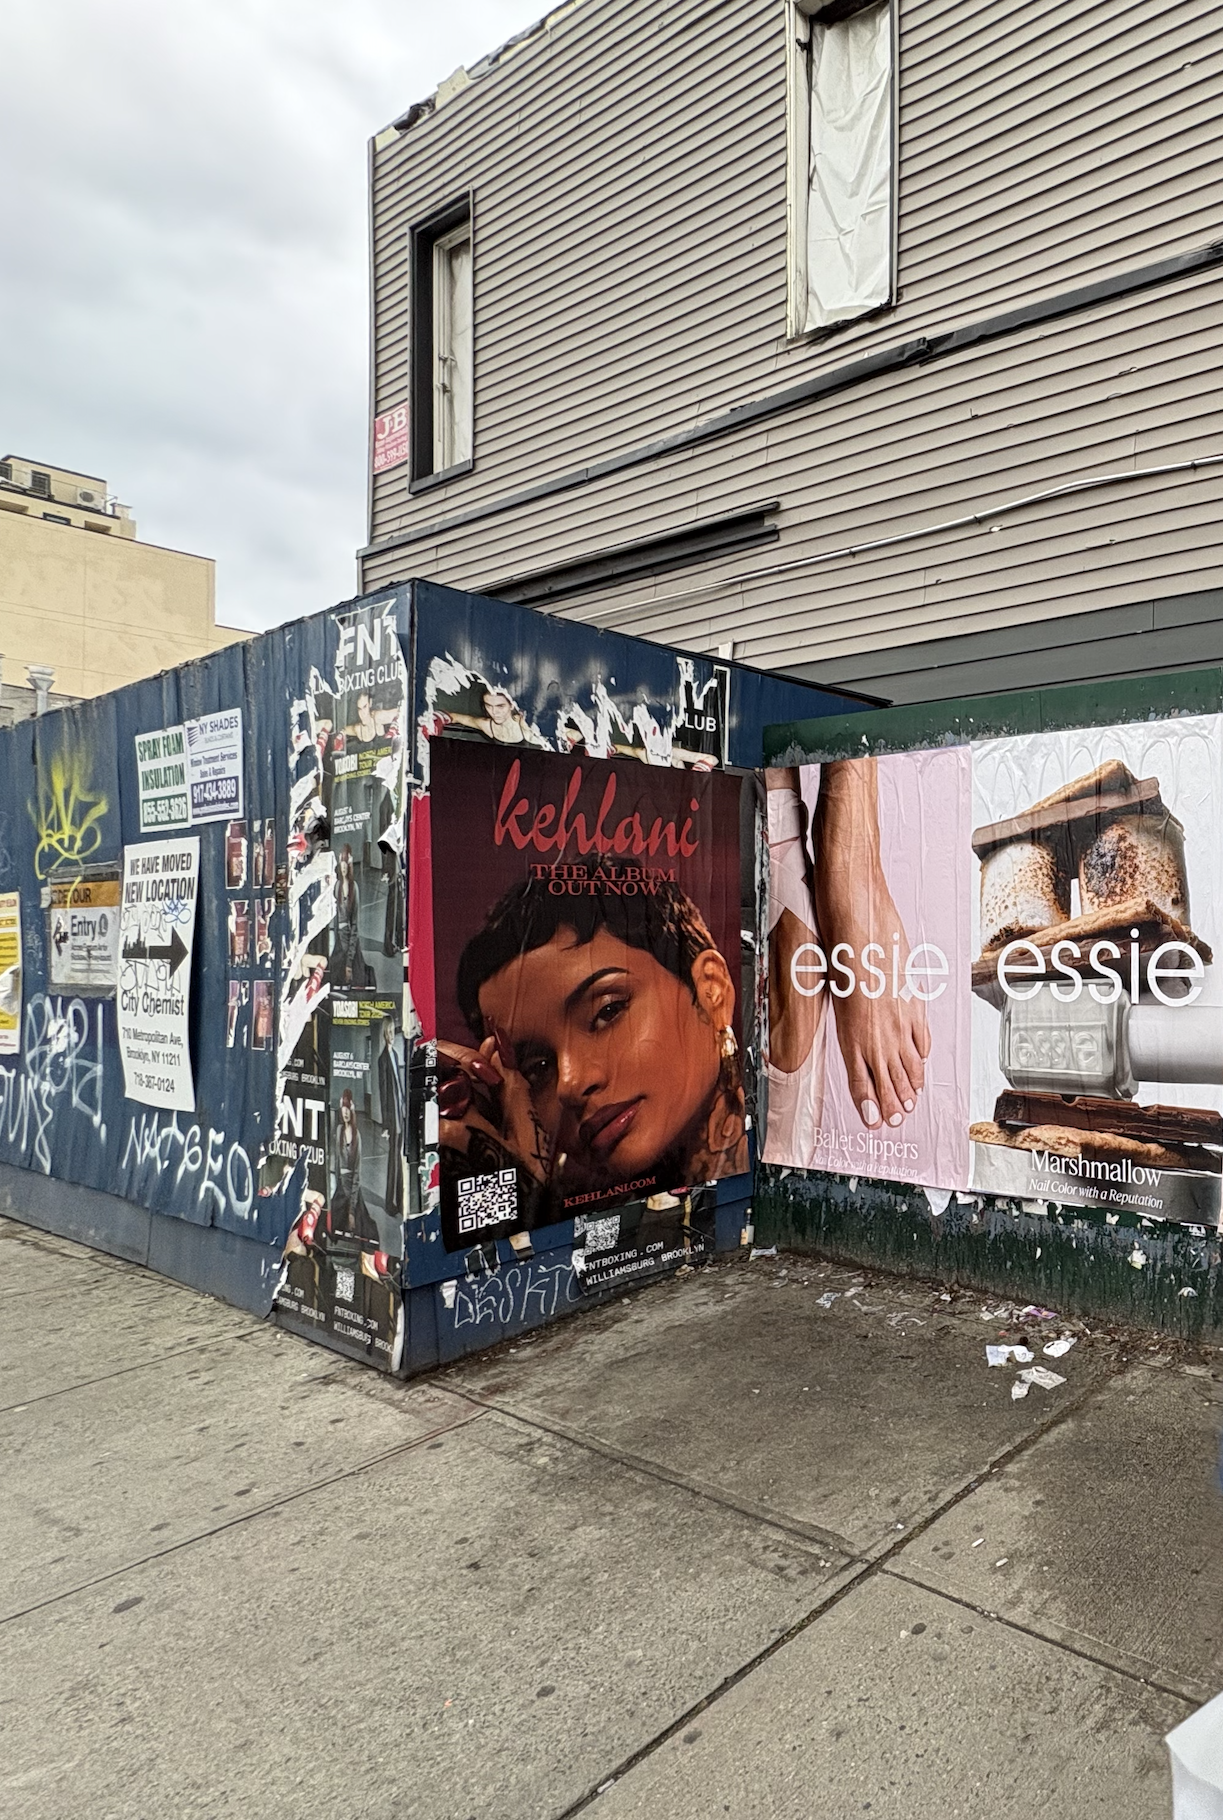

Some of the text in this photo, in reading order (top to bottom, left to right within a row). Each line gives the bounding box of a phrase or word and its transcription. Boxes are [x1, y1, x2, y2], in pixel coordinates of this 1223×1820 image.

[210, 716, 239, 733] SHADES
[684, 712, 717, 732] LUB
[138, 737, 161, 762] SPRAY
[162, 732, 185, 758] FOAM
[141, 762, 185, 791] INSULATION
[495, 758, 700, 858] kehlani
[130, 852, 192, 876] WE HAVE MOVED
[530, 863, 676, 883] THE ALBUM
[125, 877, 195, 904] NEW LOCATION
[548, 880, 663, 896] OUT NOW
[71, 914, 96, 942] Entry
[791, 932, 949, 1001] essie
[997, 928, 1205, 1007] essie
[121, 989, 184, 1016] City Chemist
[132, 1028, 168, 1045] Metropolitan
[151, 1050, 161, 1064] NY
[162, 1053, 181, 1067] 11211
[281, 1094, 325, 1141] NT
[813, 1127, 918, 1160] Ballet Slippers
[1031, 1149, 1162, 1187] Marshmallow
[564, 1176, 656, 1208] KEHLANI.COM
[1028, 1178, 1164, 1210] Nail Color with a Reputation
[586, 1243, 705, 1286] WILLIAMSBURG BROOKLYN
